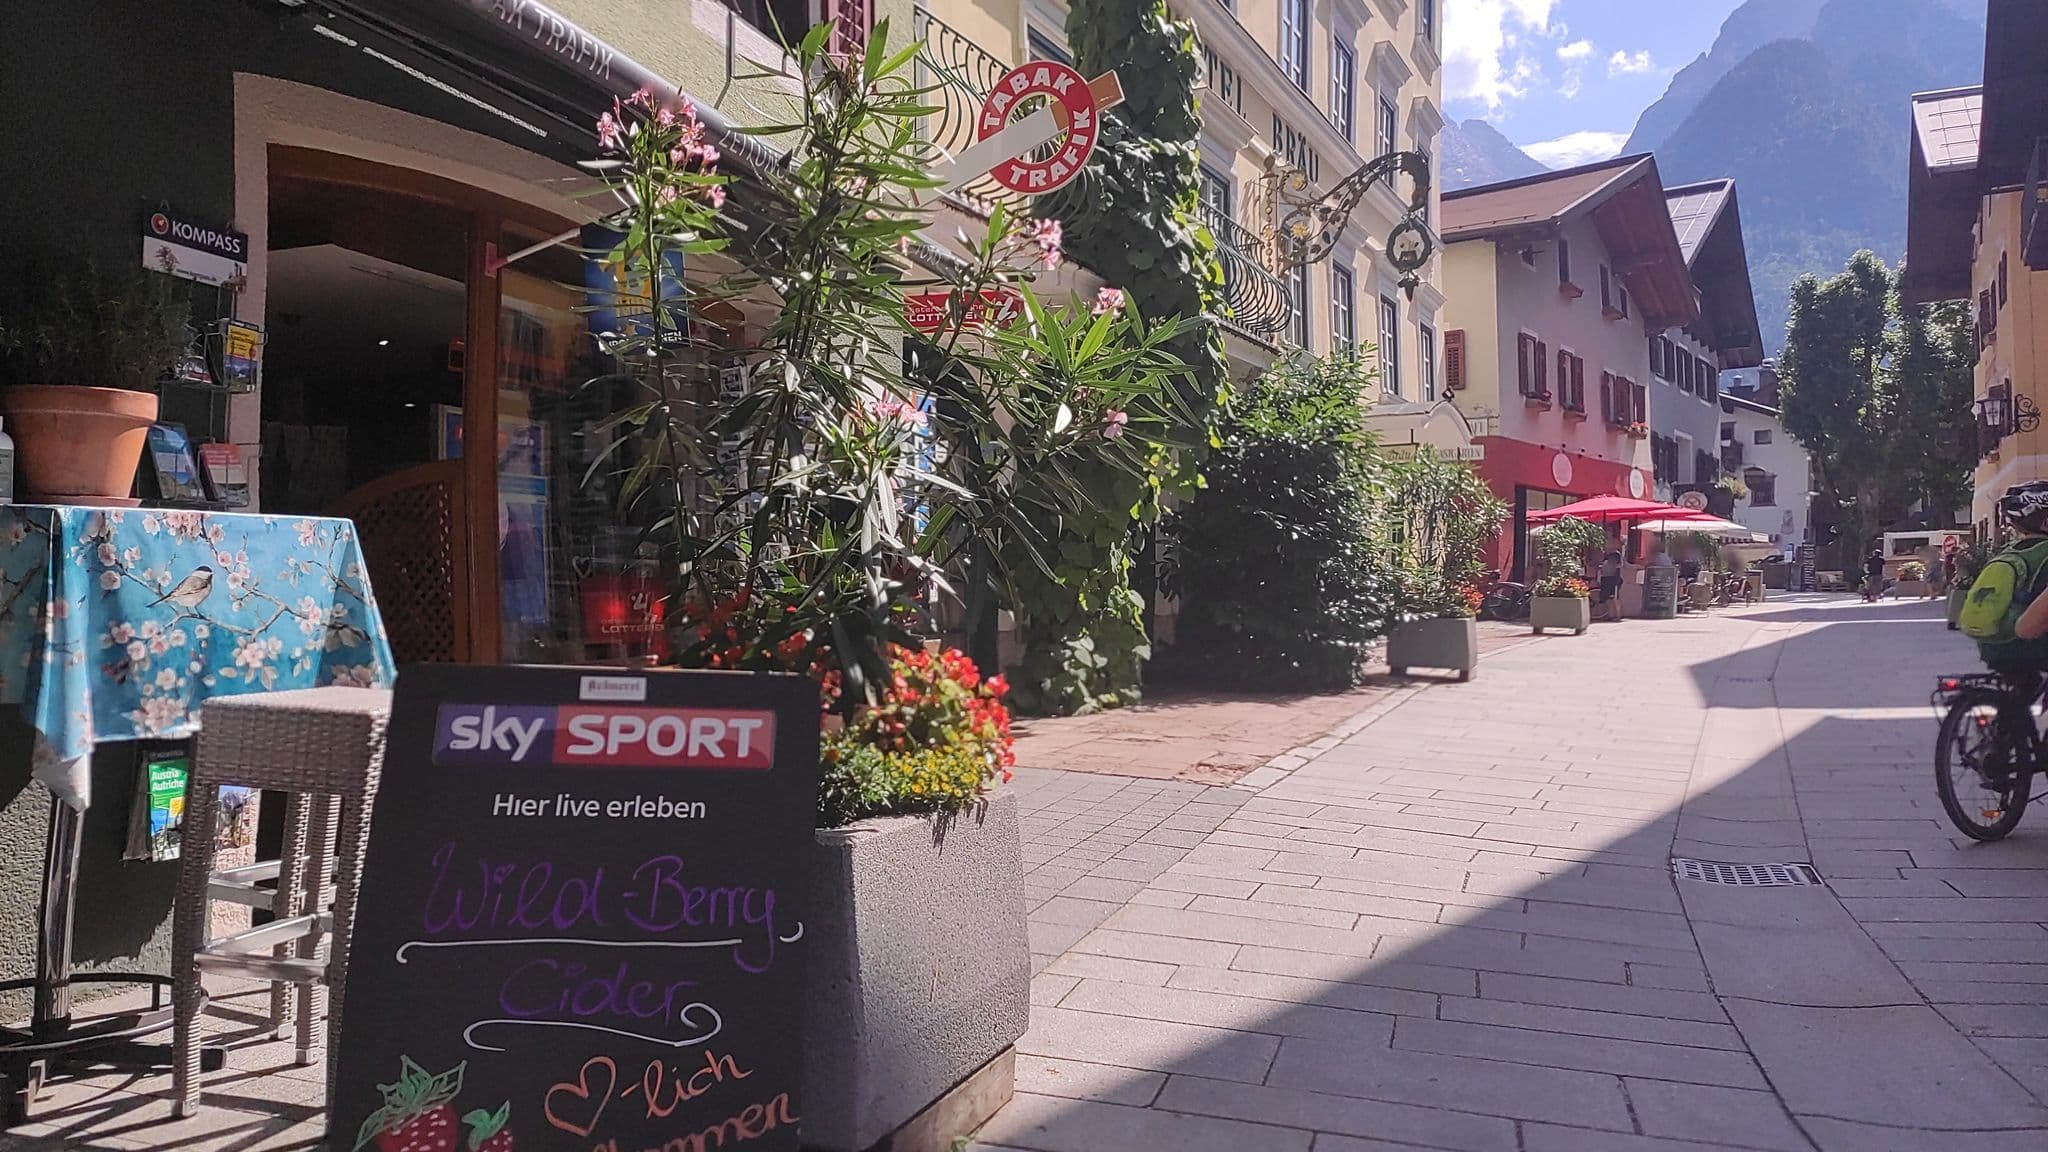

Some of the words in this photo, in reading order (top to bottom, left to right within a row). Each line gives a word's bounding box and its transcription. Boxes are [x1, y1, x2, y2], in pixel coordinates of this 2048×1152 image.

[533, 8, 613, 80] TRAFIK
[983, 67, 1076, 130] TABAK
[1009, 106, 1091, 188] TRAFIK
[172, 220, 241, 254] KOMPASS
[449, 706, 545, 762] sky
[566, 713, 763, 759] SPORT
[492, 793, 549, 817] Hier
[555, 793, 600, 817] live
[606, 795, 706, 819] erleben
[499, 959, 698, 1026] Cider
